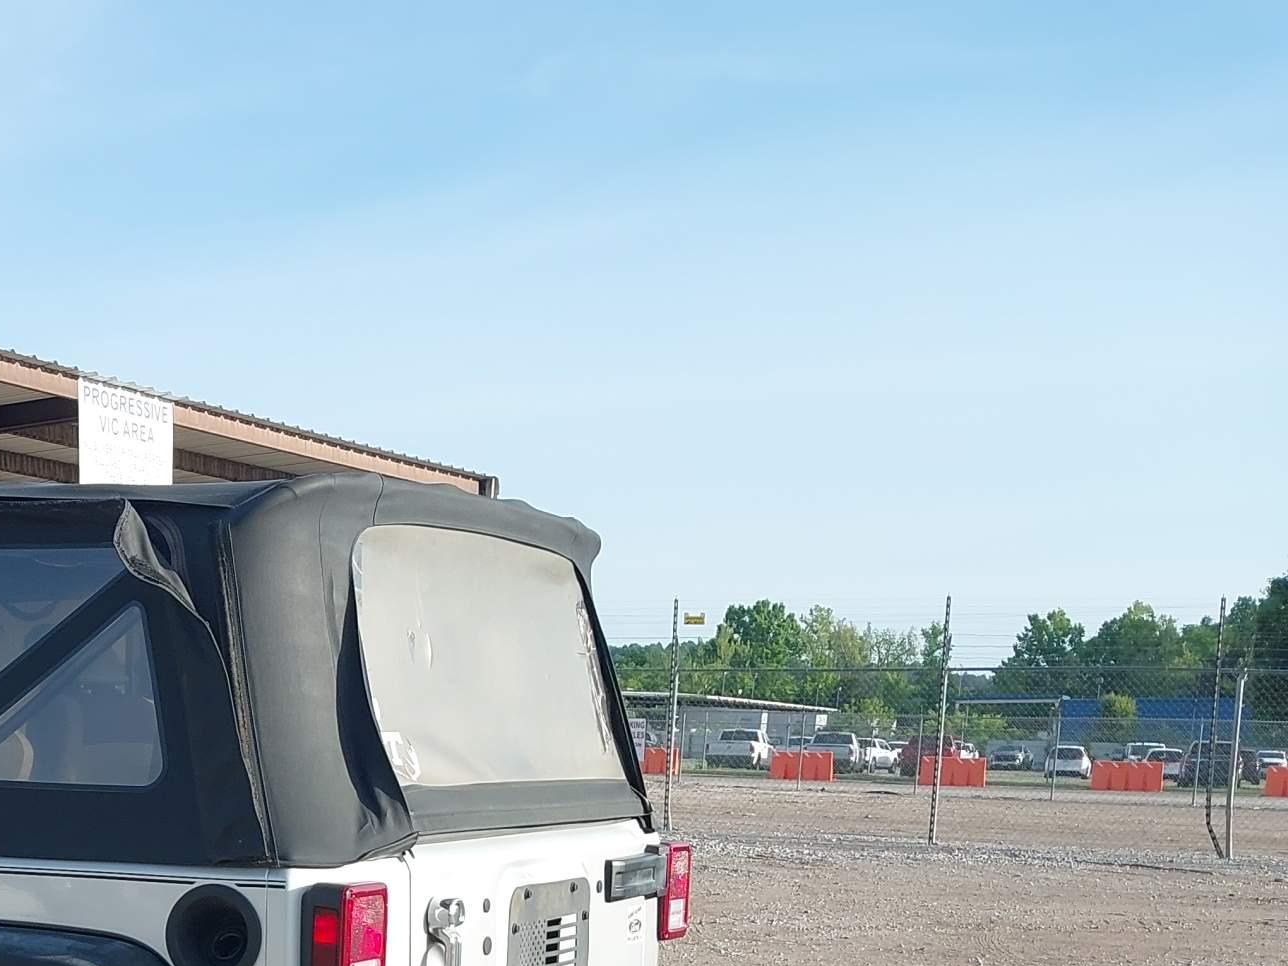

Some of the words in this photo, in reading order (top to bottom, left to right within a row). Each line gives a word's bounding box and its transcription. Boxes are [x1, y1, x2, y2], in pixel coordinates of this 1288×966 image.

[83, 385, 169, 424] PROGRESSIVE
[99, 415, 120, 436] VIC
[123, 420, 154, 442] AREA
